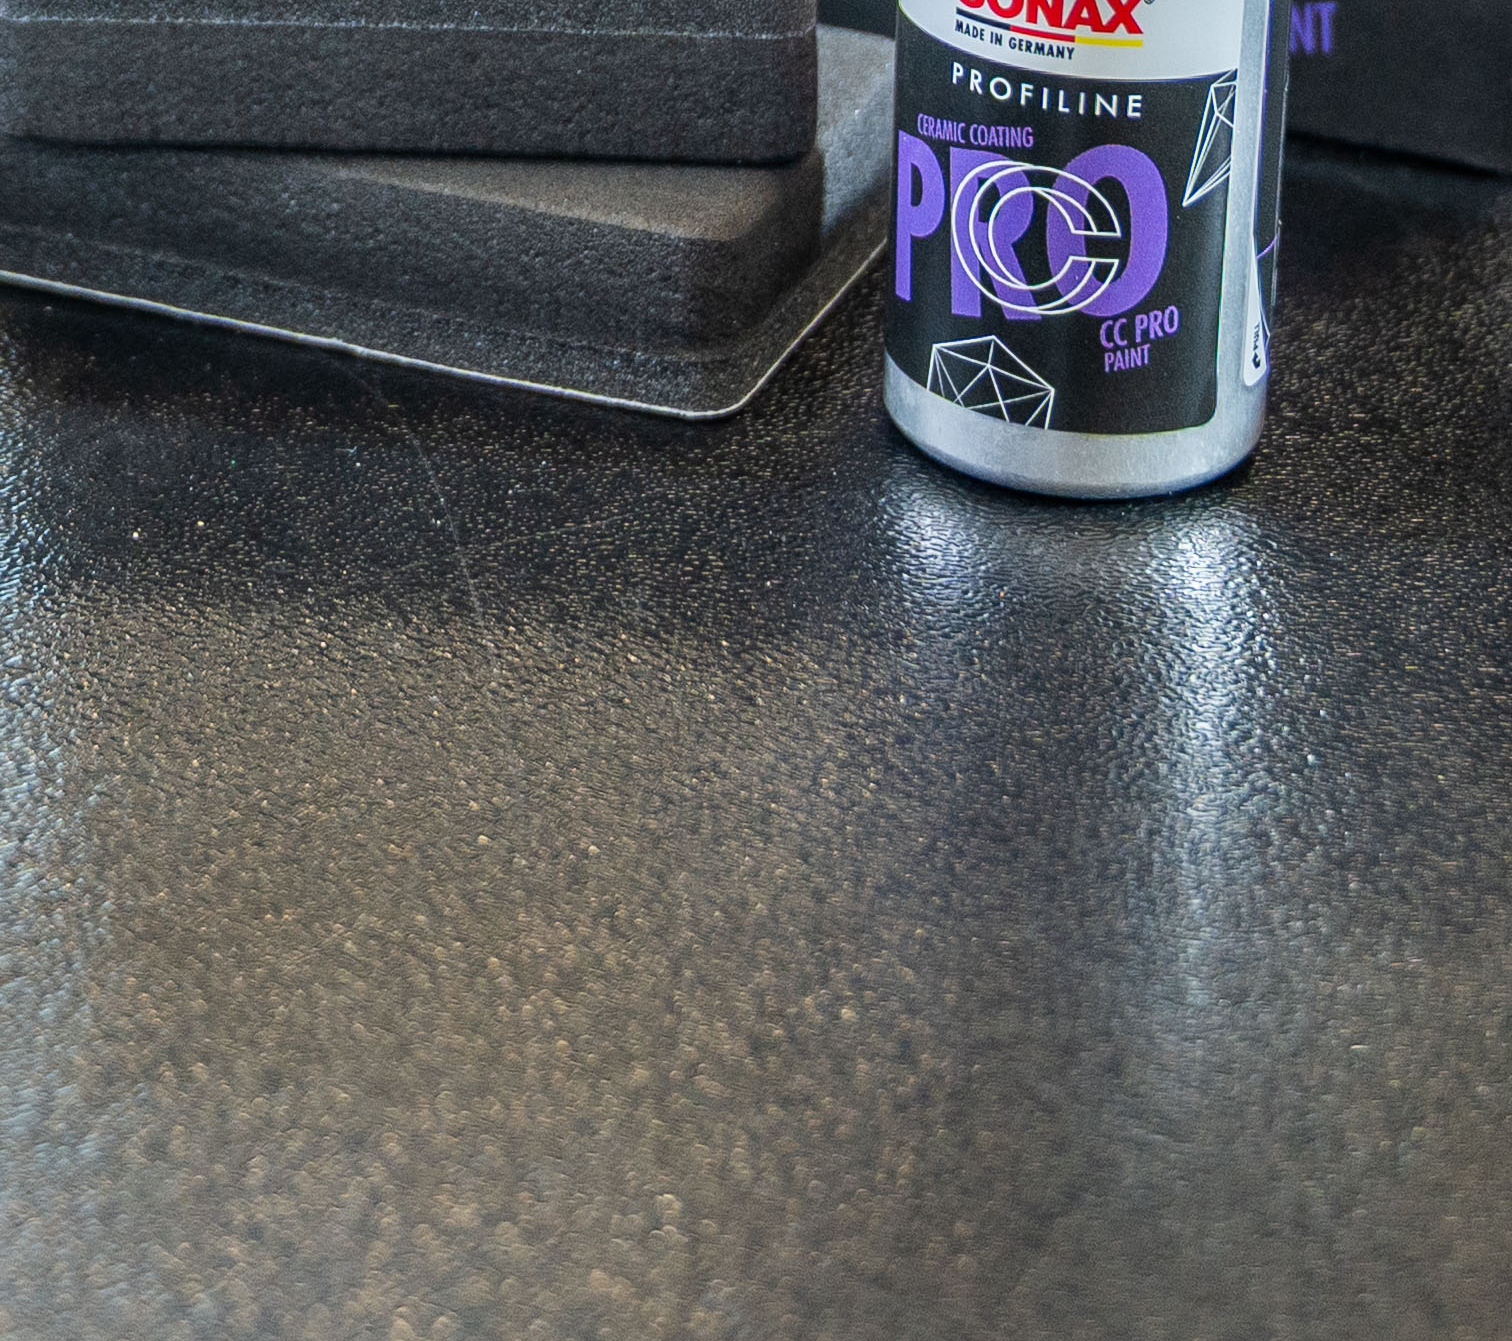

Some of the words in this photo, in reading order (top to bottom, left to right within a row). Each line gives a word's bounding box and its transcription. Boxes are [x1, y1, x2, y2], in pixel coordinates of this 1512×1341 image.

[954, 18, 986, 42] MADE
[989, 30, 1004, 47] IN
[1008, 36, 1076, 61] GERMANY
[952, 60, 1143, 119] PROFILINE
[917, 113, 967, 145] CERAMIC
[969, 123, 1035, 149] COATING
[894, 128, 1169, 321] PRO
[1099, 318, 1129, 350] CC
[1135, 305, 1180, 344] PRO
[1104, 343, 1152, 374] PAINT
